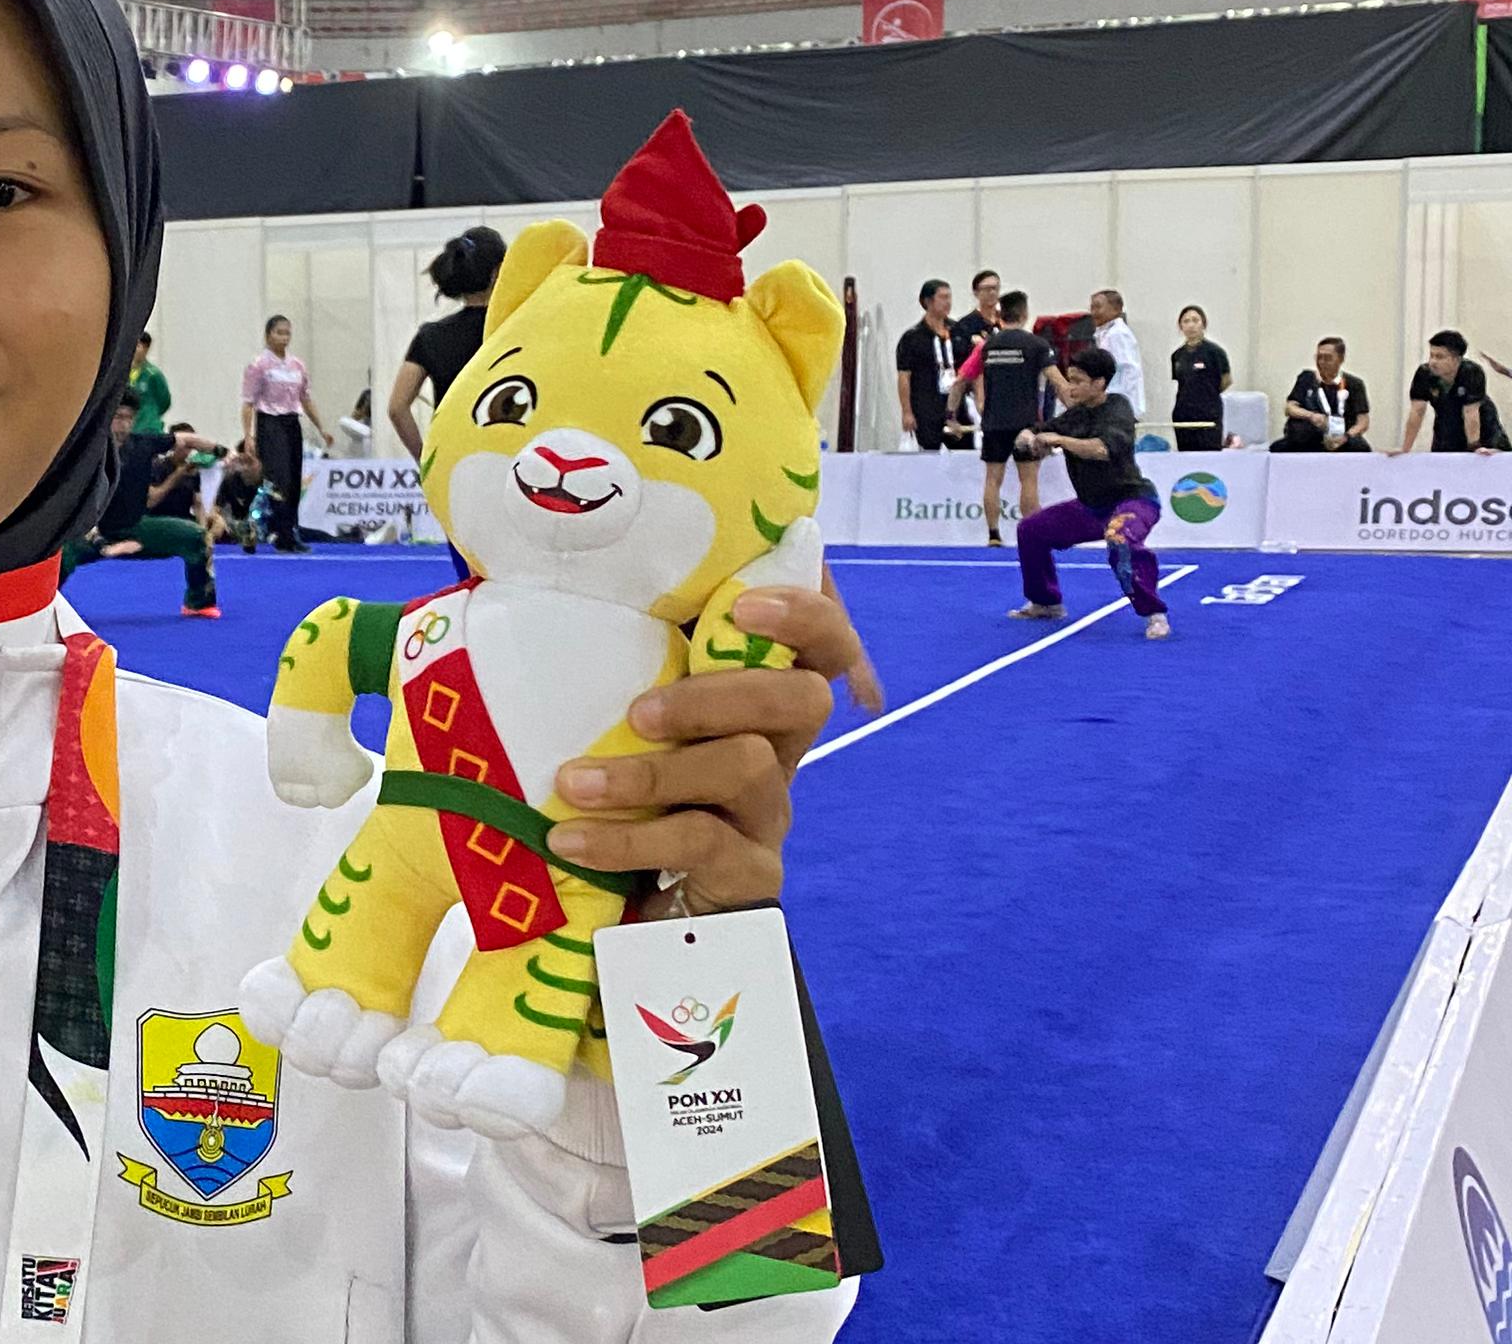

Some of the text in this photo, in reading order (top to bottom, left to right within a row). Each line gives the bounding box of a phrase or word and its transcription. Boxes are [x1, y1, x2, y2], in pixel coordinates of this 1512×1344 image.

[328, 469, 422, 489] PON XX
[895, 497, 983, 520] Barito
[1359, 487, 1512, 525] indos
[668, 1088, 742, 1109] PON XXI
[673, 1110, 744, 1126] ACEH-SUMUT
[696, 1125, 724, 1136] 2024
